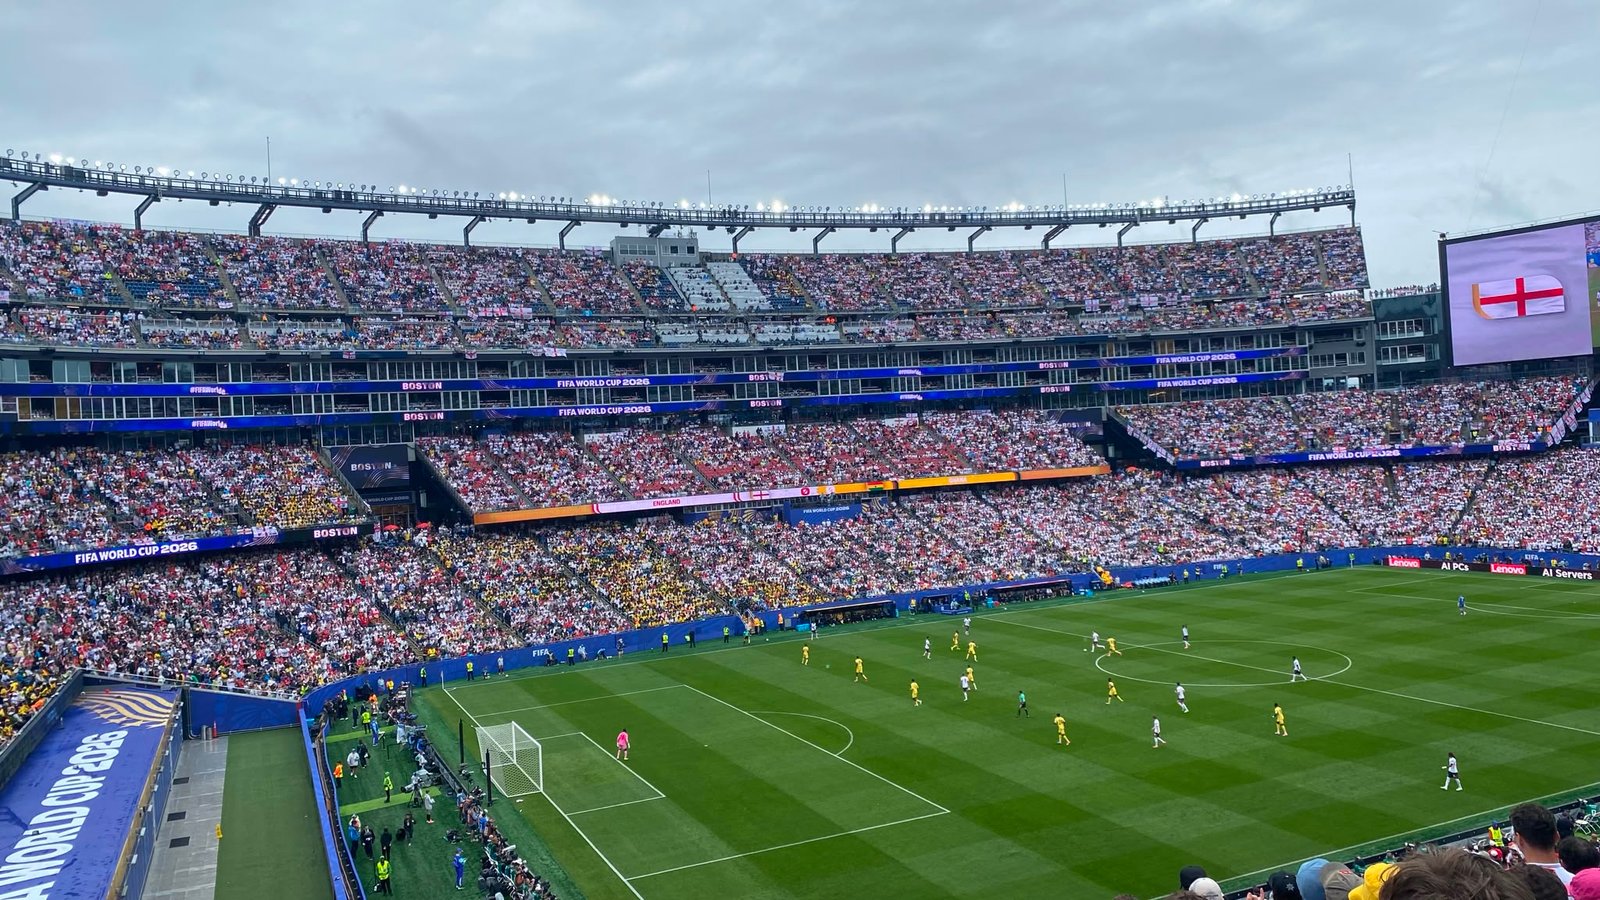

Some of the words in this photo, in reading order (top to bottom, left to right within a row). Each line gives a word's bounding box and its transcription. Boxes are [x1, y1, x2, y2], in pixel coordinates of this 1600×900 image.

[402, 382, 442, 390] BOSTON
[404, 412, 444, 420] BOSTON
[1326, 452, 1354, 460] WORLD
[350, 462, 392, 471] BOSTON
[314, 527, 358, 538] BOSTON
[75, 552, 98, 564] FIFA
[99, 548, 138, 560] WORLD
[138, 546, 160, 556] CUP
[160, 542, 198, 554] 2026
[1388, 558, 1420, 568] Lenovo
[1442, 562, 1451, 570] AI
[1453, 563, 1470, 571] PCs
[1490, 564, 1524, 574] Lenovo
[1542, 568, 1552, 577] AI
[1556, 569, 1592, 580] Servers
[532, 648, 548, 657] FIFA
[62, 730, 128, 776] 2026
[41, 775, 106, 806] CUP
[0, 806, 91, 888] WORLD
